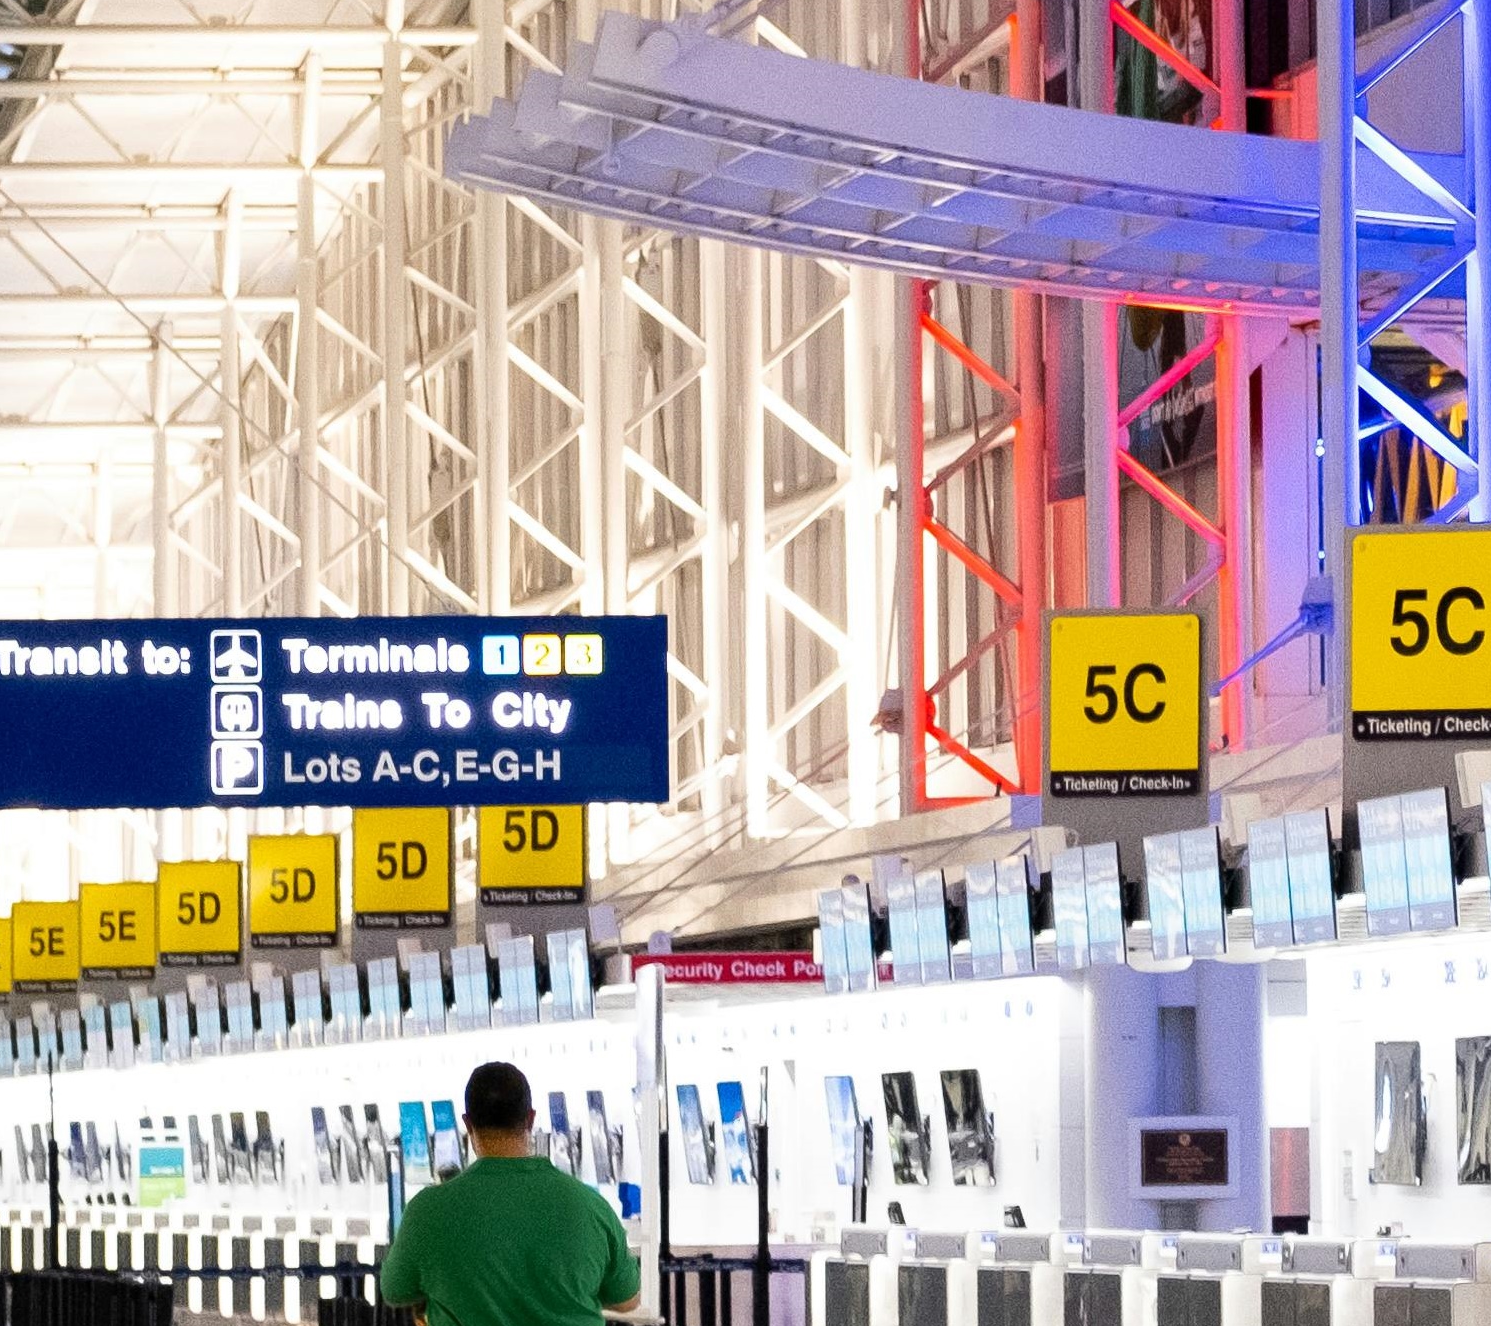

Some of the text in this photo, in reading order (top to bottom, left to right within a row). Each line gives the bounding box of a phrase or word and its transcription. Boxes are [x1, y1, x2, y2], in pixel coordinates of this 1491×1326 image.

[1389, 585, 1485, 657] 5C
[144, 640, 192, 677] to:
[283, 639, 469, 675] Terminals
[1083, 662, 1167, 725] 5C
[283, 692, 572, 735] Trains To City
[1366, 717, 1432, 736] Ticketing
[284, 753, 360, 783] Lots
[1063, 775, 1123, 793] Ticketing
[1130, 774, 1185, 791] Check-In
[503, 809, 559, 853] 5D
[376, 840, 428, 881] 5D
[269, 867, 316, 904] 5D
[98, 910, 137, 942] 5E
[177, 891, 221, 925] 5D
[29, 926, 65, 957] 5E
[665, 960, 723, 980] ecurity
[731, 960, 786, 977] Check
